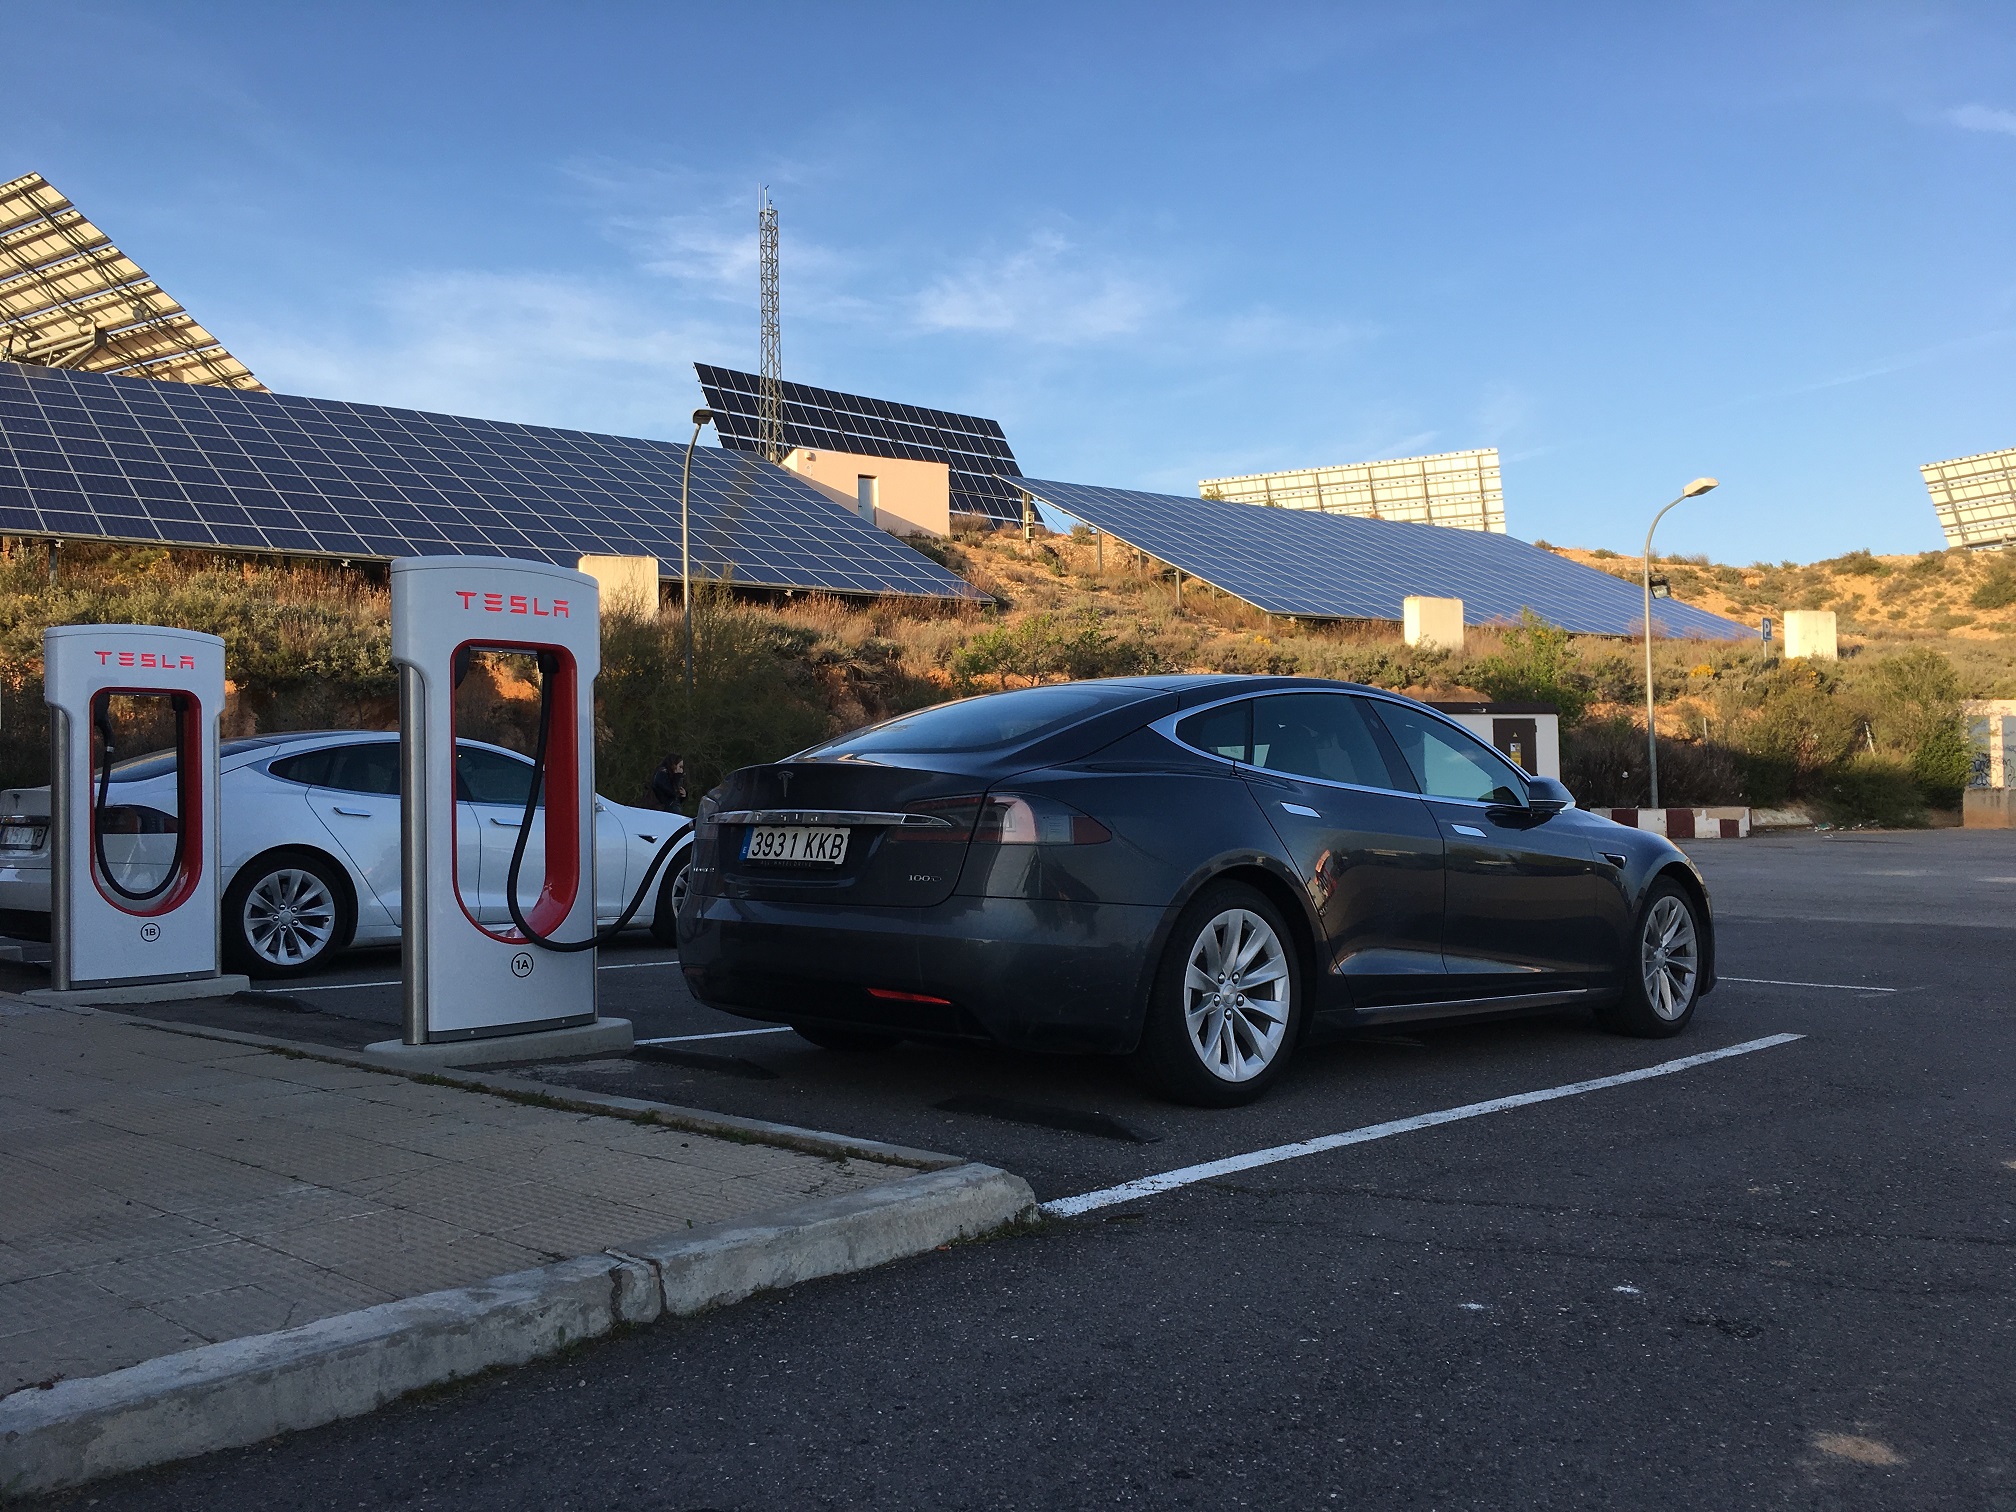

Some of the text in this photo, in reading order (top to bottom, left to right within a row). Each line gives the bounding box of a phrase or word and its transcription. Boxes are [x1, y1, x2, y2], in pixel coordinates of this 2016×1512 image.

[455, 591, 569, 619] TESLA
[94, 651, 195, 670] TESLA
[742, 846, 747, 854] E
[751, 832, 844, 860] 3931 KKB
[144, 928, 156, 937] 1B
[515, 959, 530, 970] 1A
